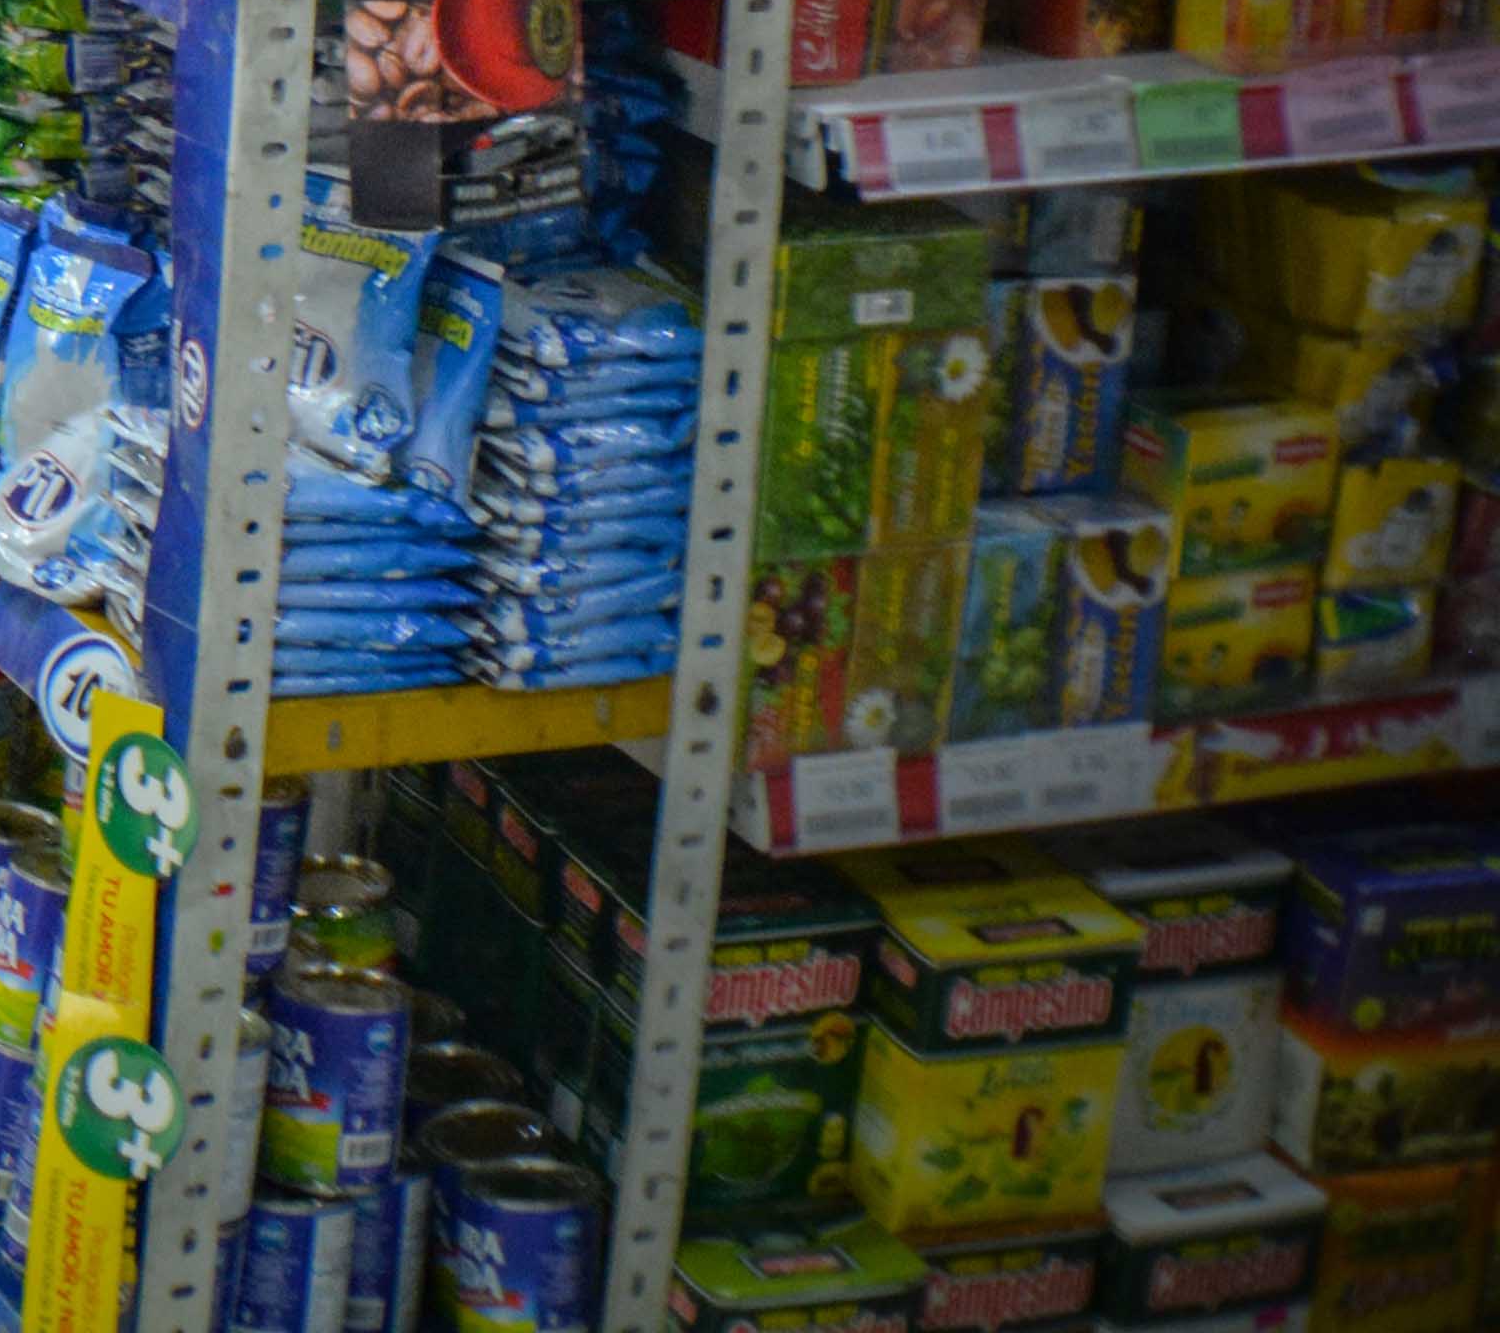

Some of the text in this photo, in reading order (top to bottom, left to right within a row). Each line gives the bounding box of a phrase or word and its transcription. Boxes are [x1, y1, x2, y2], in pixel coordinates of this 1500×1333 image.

[102, 874, 122, 907] TU
[944, 974, 1114, 1042] Campesino
[917, 1256, 1098, 1333] Campesino
